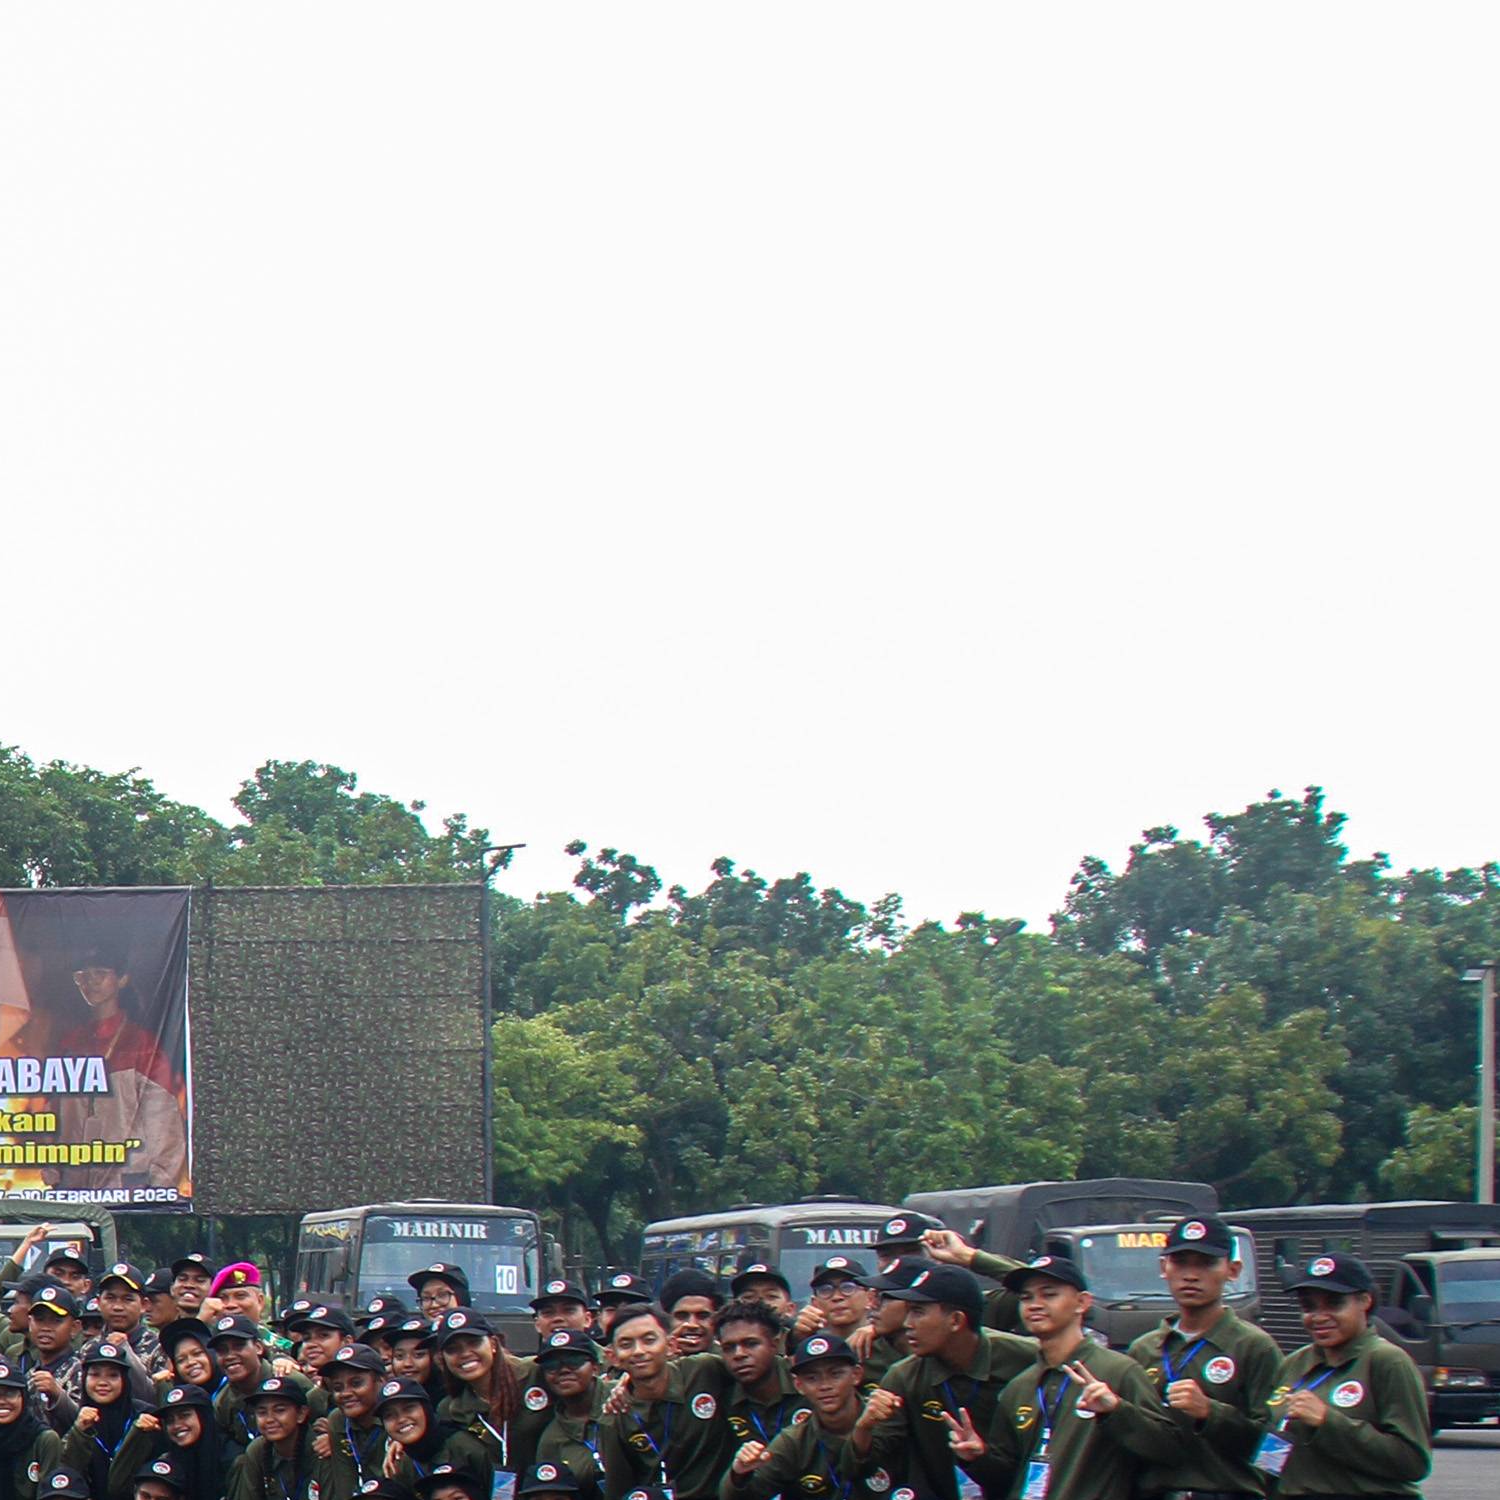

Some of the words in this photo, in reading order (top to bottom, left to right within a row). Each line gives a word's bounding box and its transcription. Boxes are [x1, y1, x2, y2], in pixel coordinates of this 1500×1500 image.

[133, 1188, 178, 1202] 2026
[391, 1221, 489, 1240] MARINIR
[497, 1269, 515, 1291] 10
